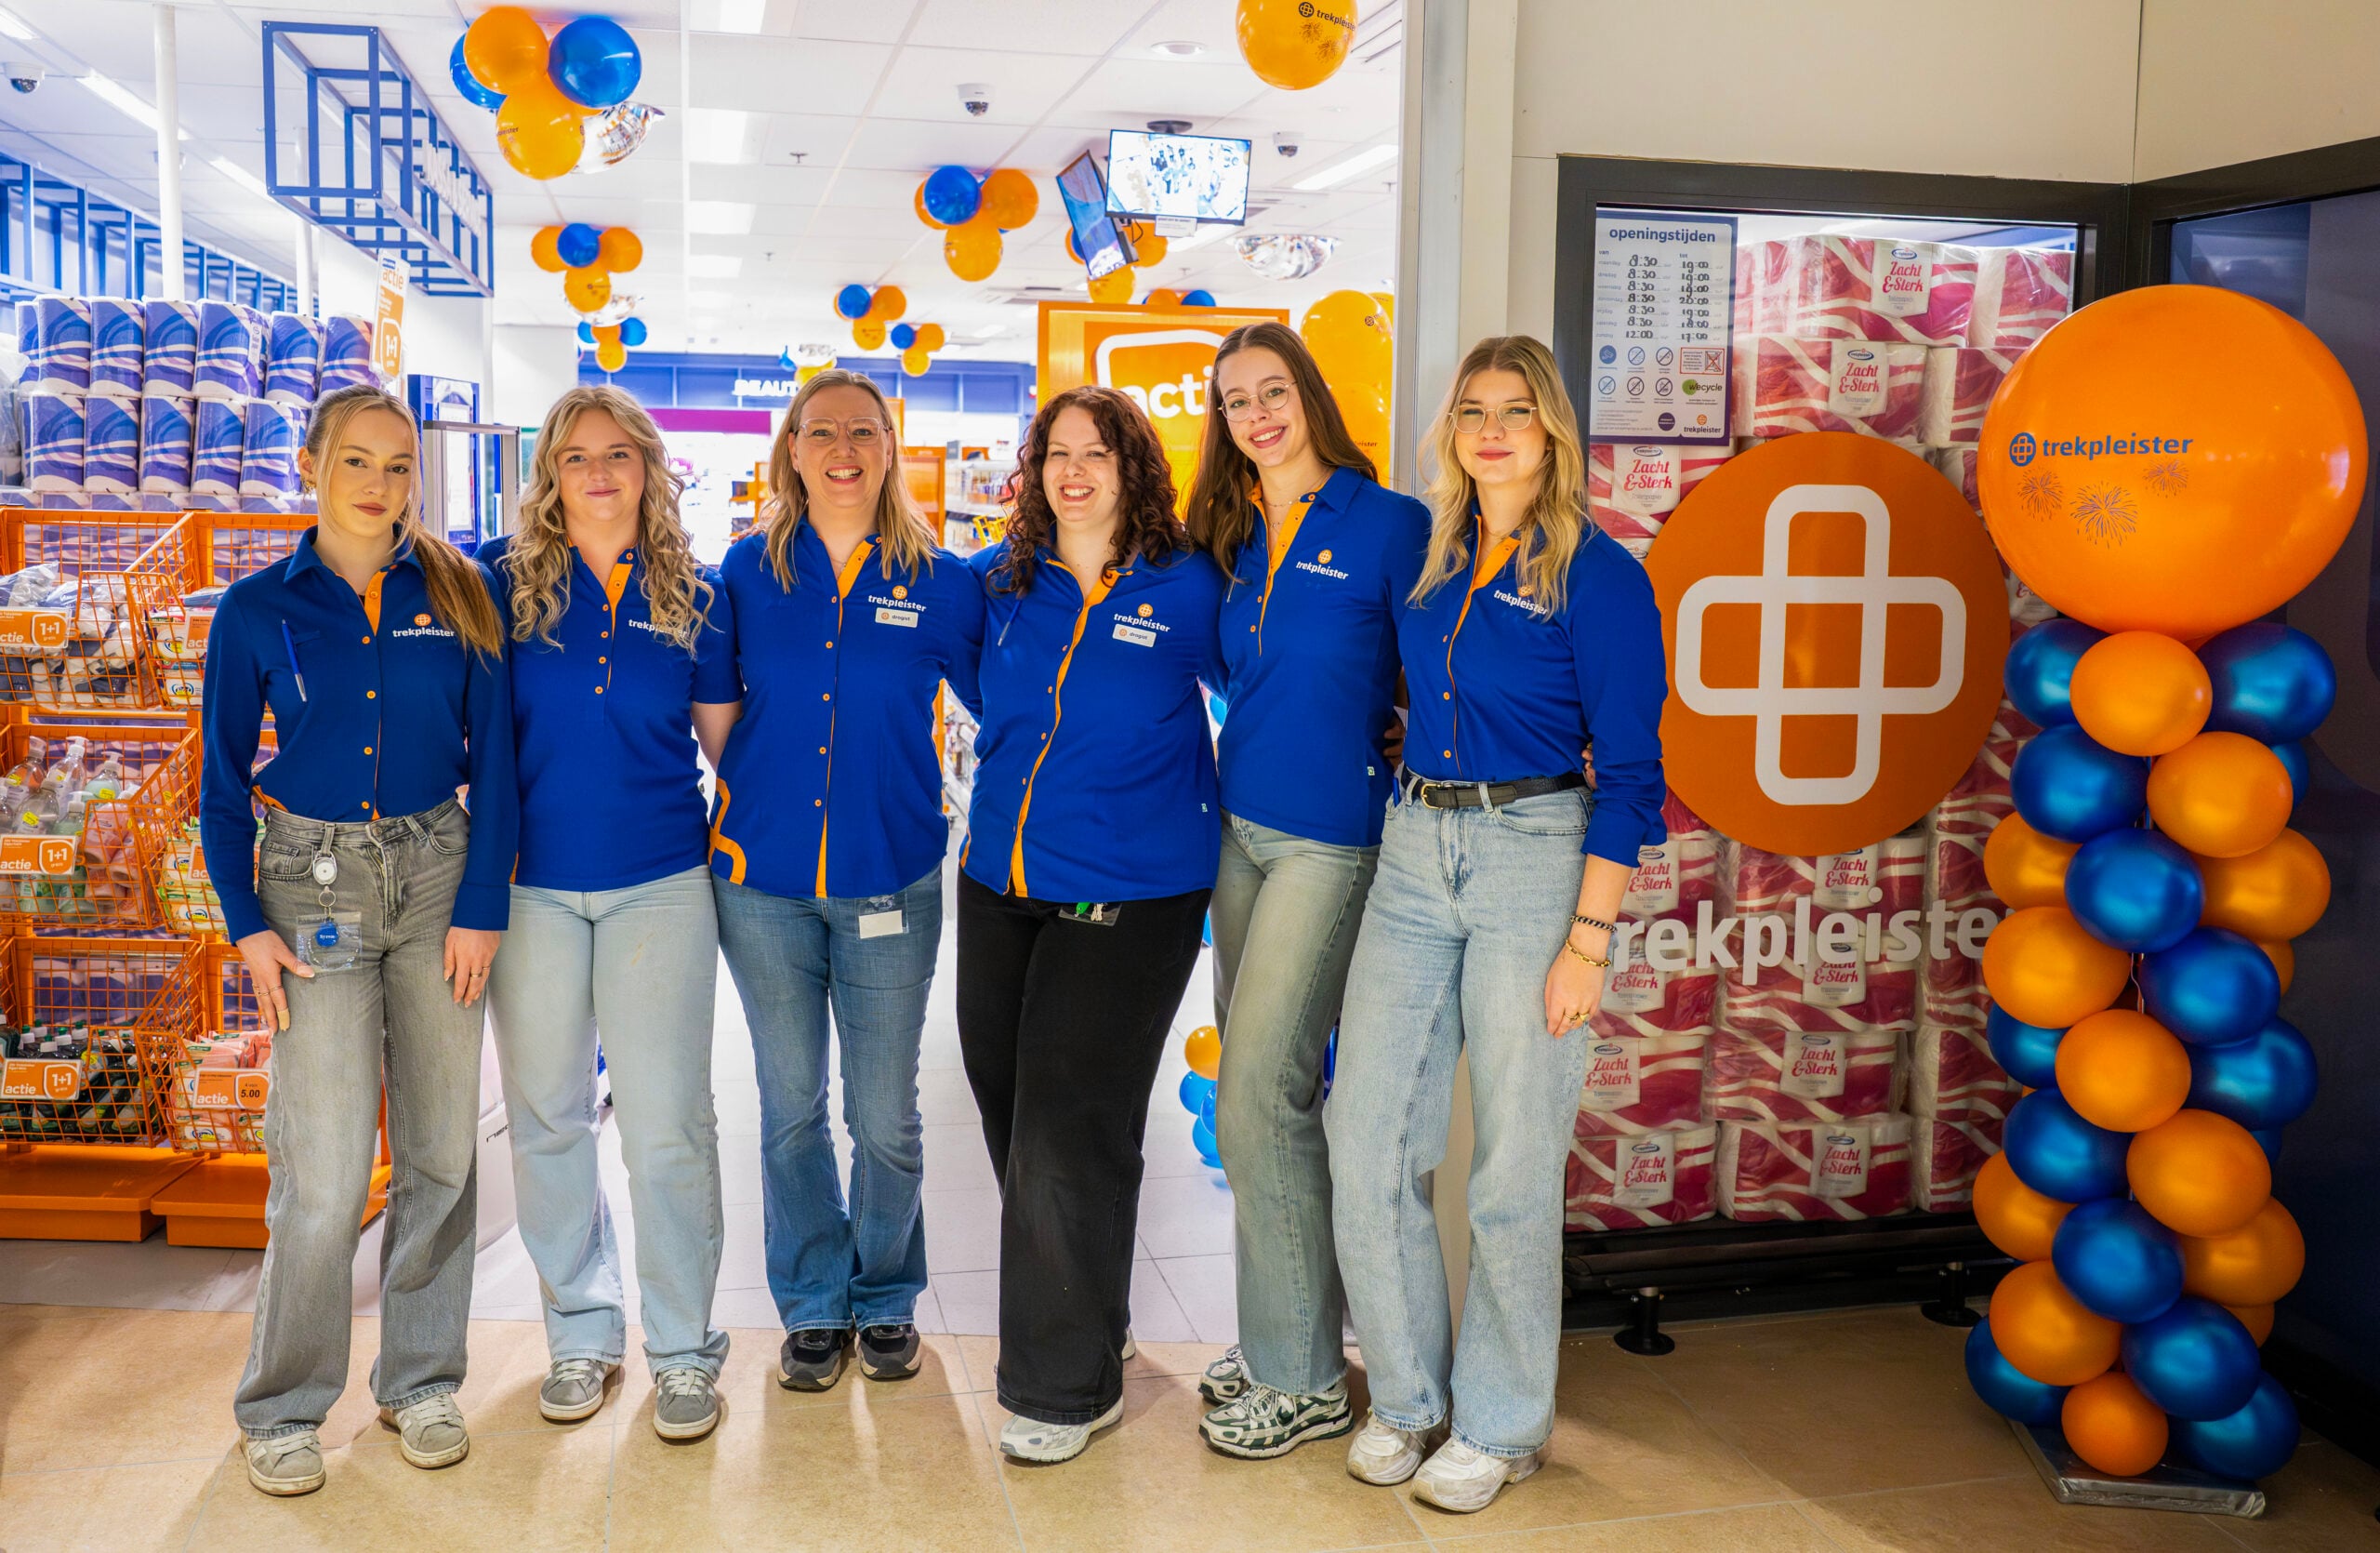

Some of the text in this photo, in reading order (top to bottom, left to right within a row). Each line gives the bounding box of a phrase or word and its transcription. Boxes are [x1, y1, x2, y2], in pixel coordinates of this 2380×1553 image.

[1609, 227, 1716, 244] openingstijden
[1890, 261, 1922, 276] Zacht
[1845, 362, 1879, 377] Zacht
[732, 379, 800, 396] BEAUT
[1119, 365, 1213, 419] acti
[1684, 426, 1721, 434] trekpleister
[2043, 432, 2193, 460] trekpleister
[1633, 459, 1670, 473] Zacht
[1623, 473, 1673, 491] &Sterk
[1296, 561, 1349, 579] trekpleister
[868, 595, 927, 612] trekpleister
[40, 622, 60, 636] 1+1
[1114, 614, 1170, 632] trekpleister
[0, 632, 24, 644] ctie
[392, 627, 455, 637] trekpleister
[188, 639, 208, 648] act
[47, 848, 68, 862] 1+1
[1, 858, 32, 869] actie
[1637, 862, 1671, 876] Zacht
[1832, 857, 1868, 871] Zacht
[1614, 886, 2016, 986] rekpleiste
[1801, 1047, 1835, 1061] Zacht
[1593, 1057, 1628, 1071] Zacht
[52, 1072, 72, 1086] 1+1
[5, 1083, 36, 1094] actie
[241, 1089, 260, 1097] 5.00
[197, 1093, 229, 1104] actie
[1632, 1156, 1666, 1170] Zacht
